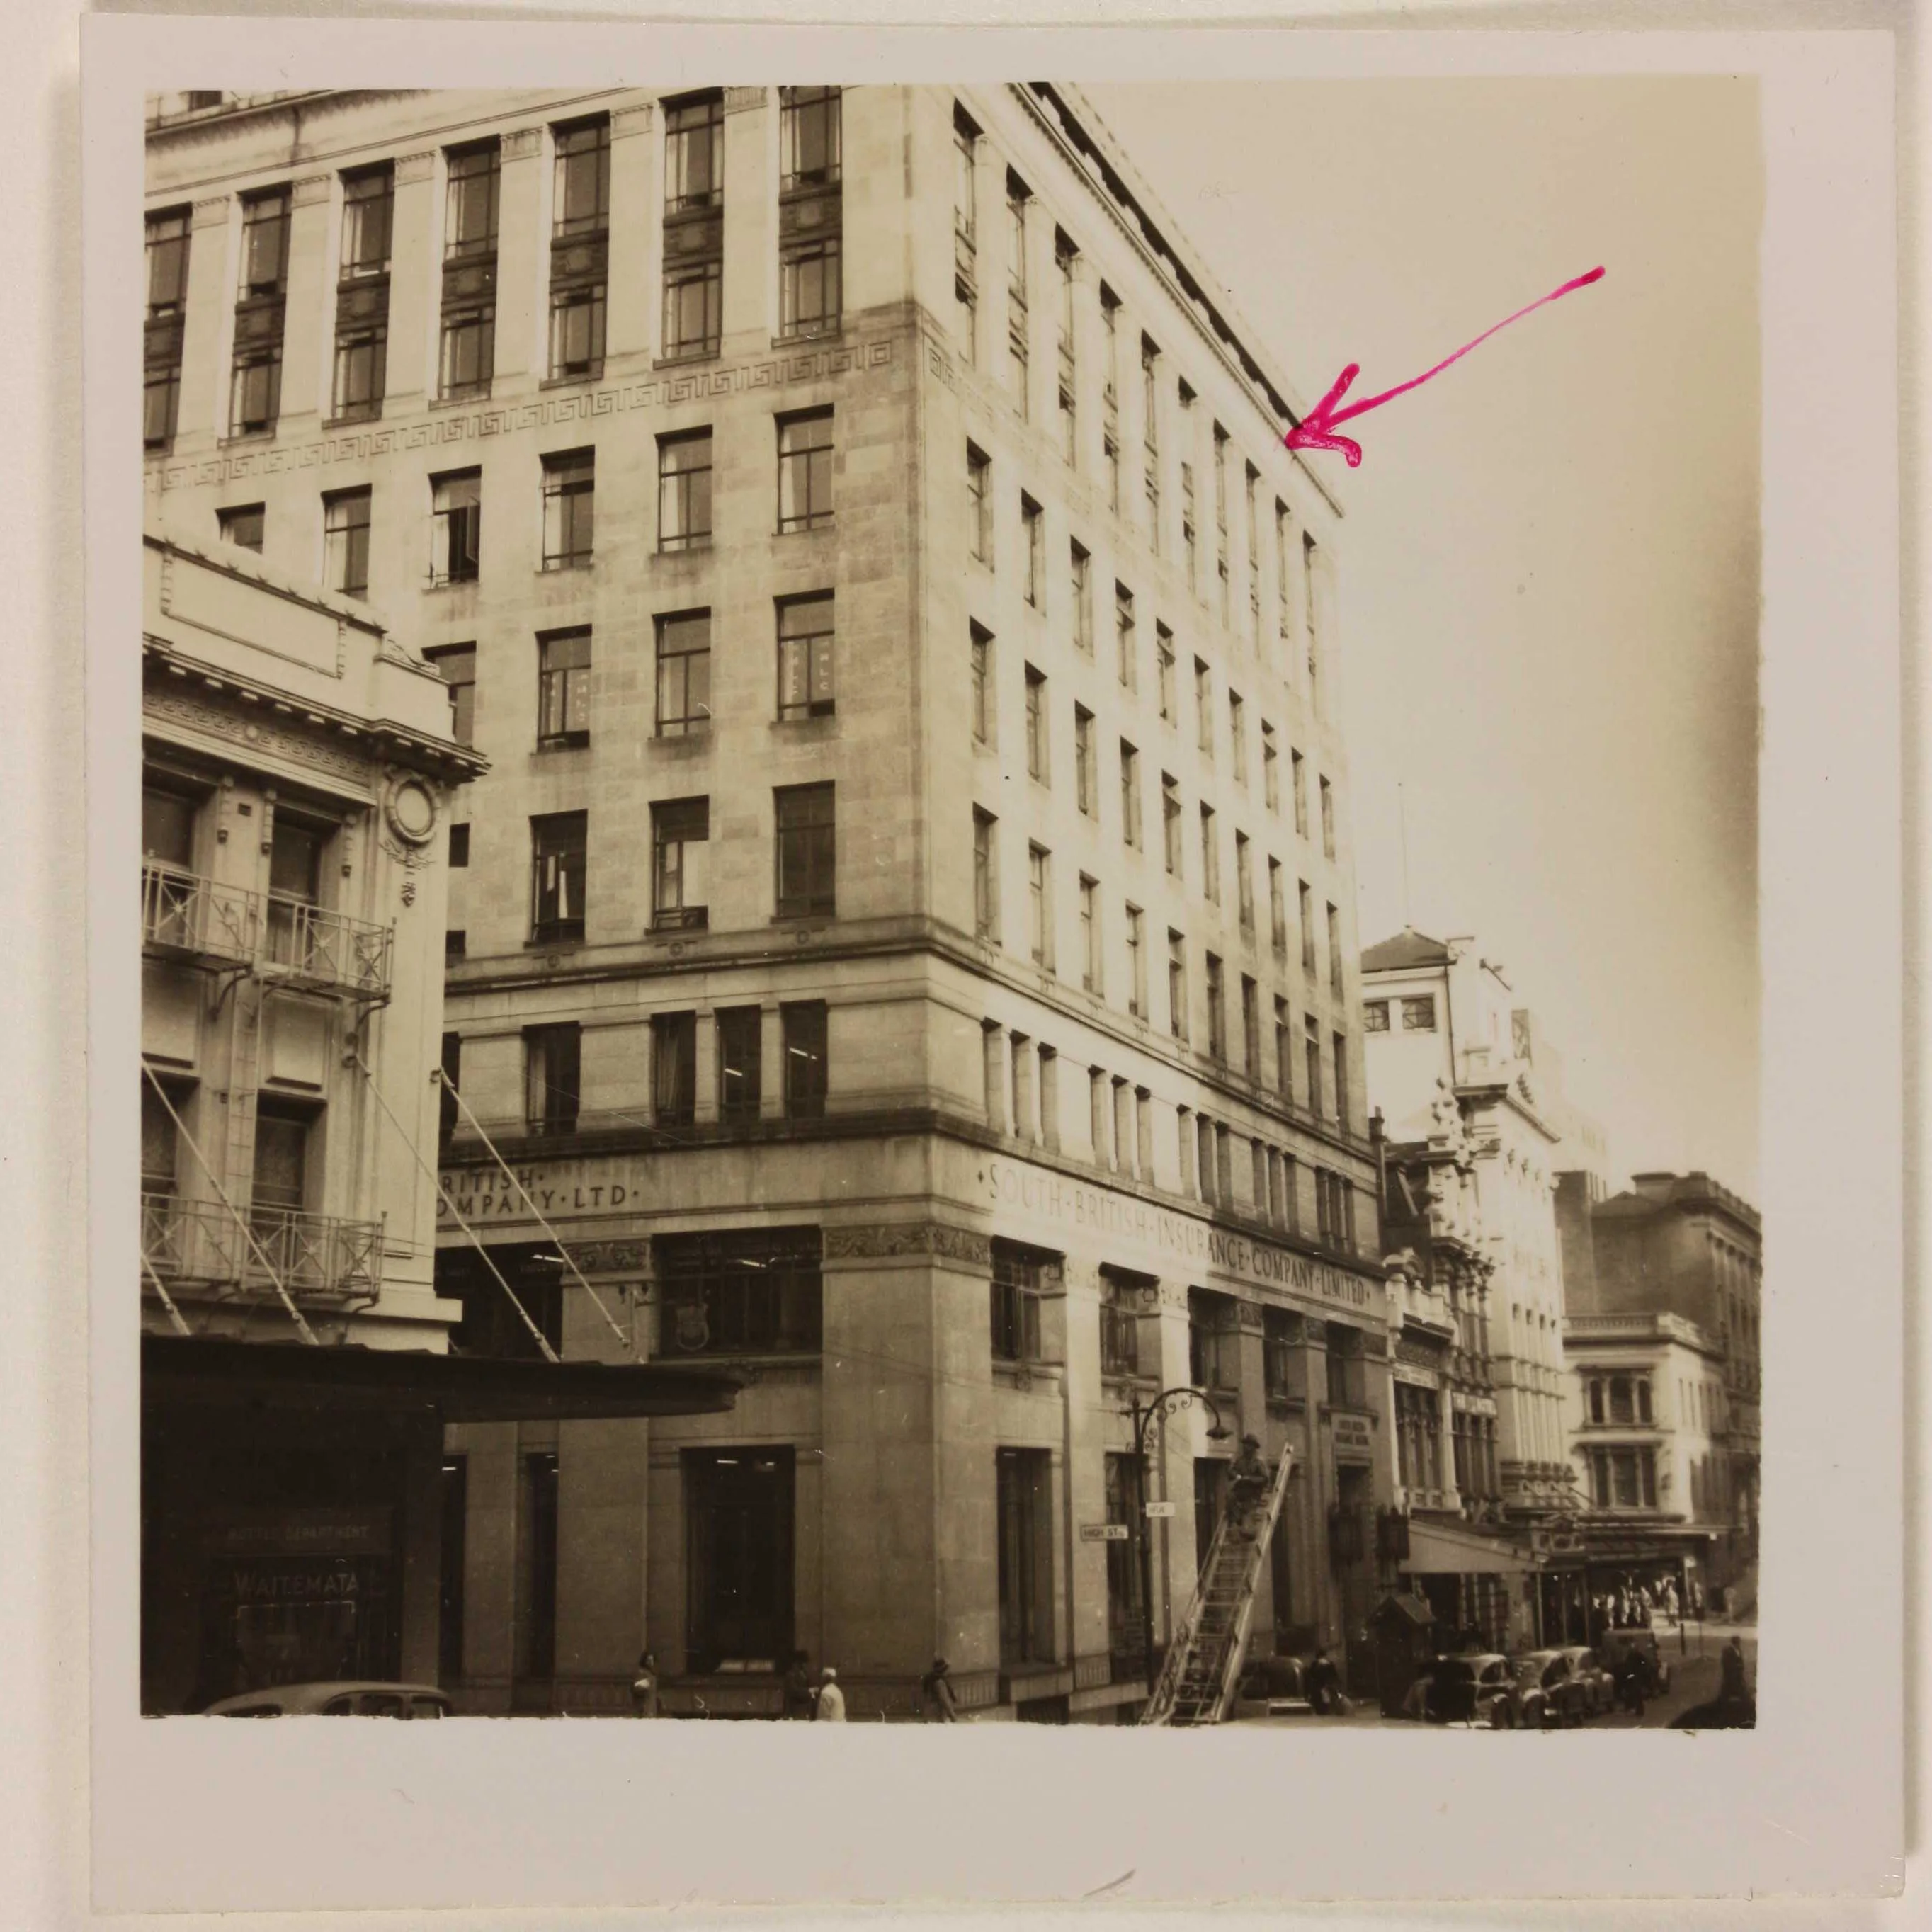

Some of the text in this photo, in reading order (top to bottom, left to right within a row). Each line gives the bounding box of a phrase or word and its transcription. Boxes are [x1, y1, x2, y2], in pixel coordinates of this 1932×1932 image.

[989, 1164, 1364, 1305] SOUTH BRITISH INSURANCE COMPANY LIMITED
[233, 1568, 360, 1599] WAITEMATA
